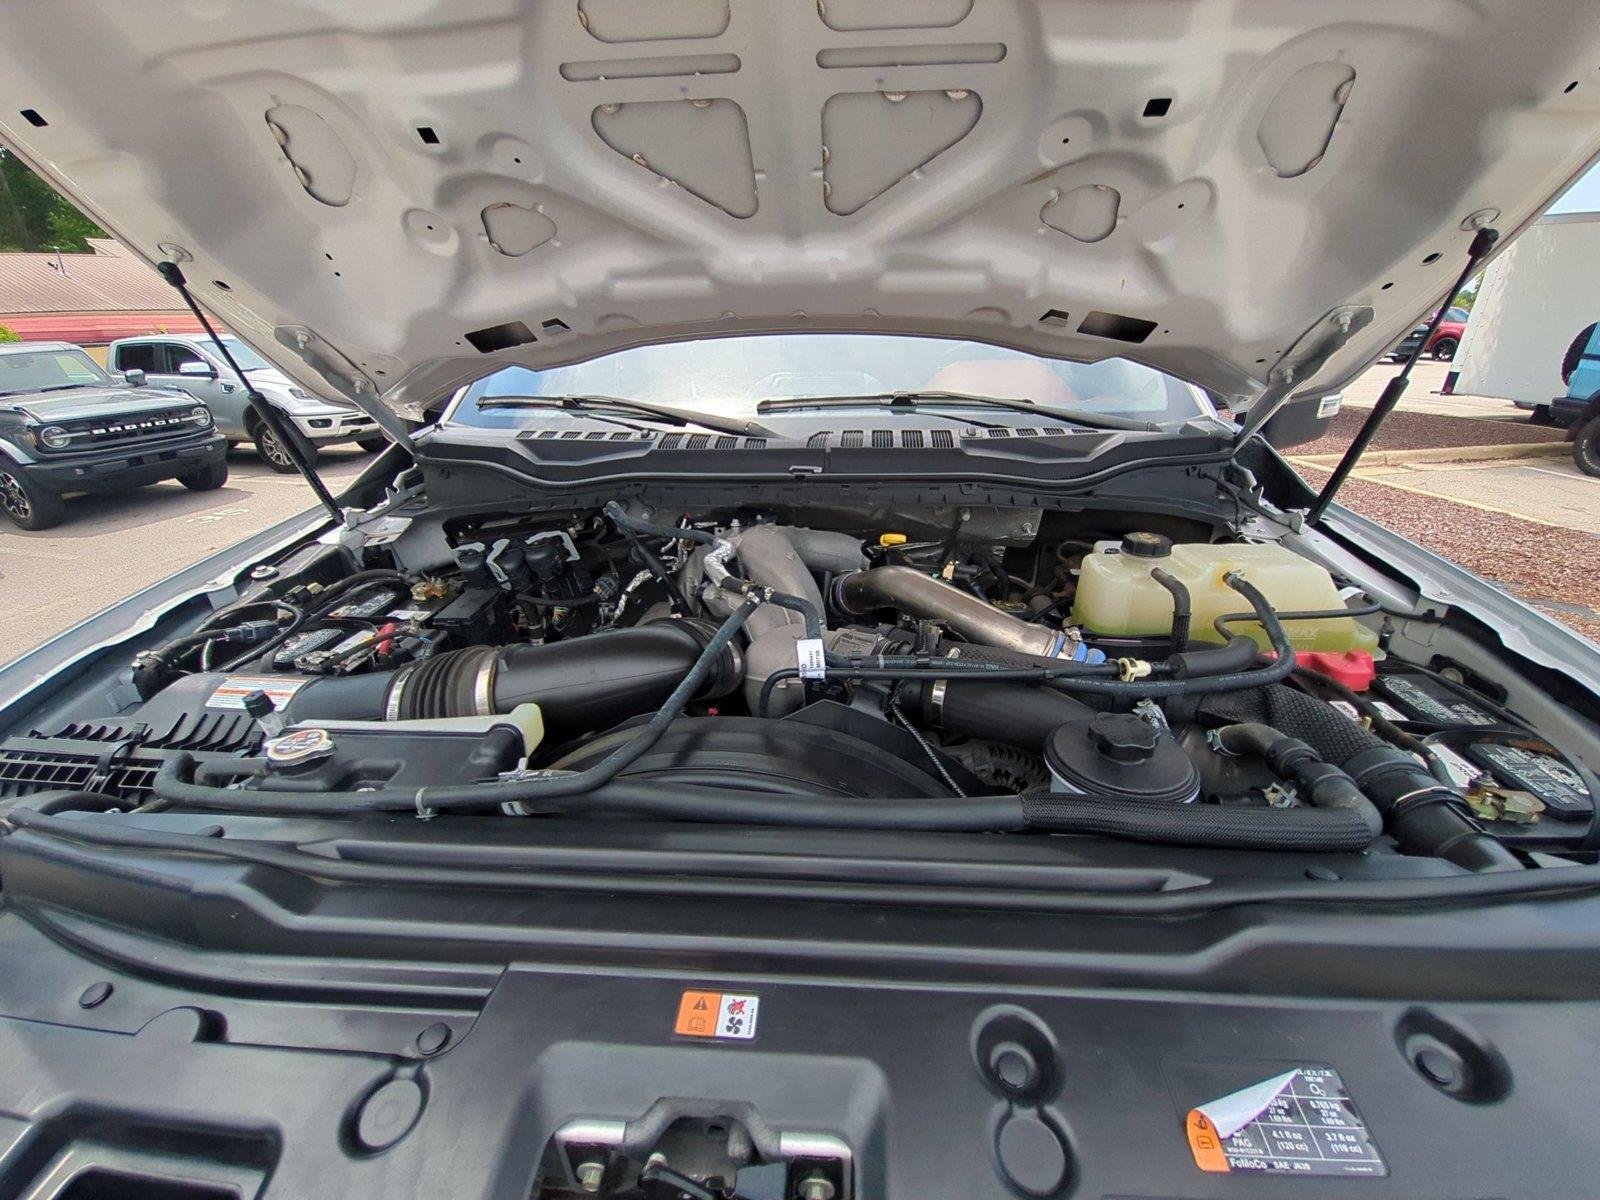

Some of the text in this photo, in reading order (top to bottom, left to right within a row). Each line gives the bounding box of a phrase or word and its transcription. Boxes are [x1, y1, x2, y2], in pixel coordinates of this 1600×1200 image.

[91, 417, 181, 435] BRONCO
[1272, 1130, 1283, 1139] 4.1
[1292, 1132, 1303, 1140] oz
[1325, 1132, 1337, 1141] 3.7
[1232, 1137, 1252, 1147] PAG
[1277, 1141, 1309, 1152] (120 cc)
[1349, 1145, 1363, 1154] cc)
[1229, 1157, 1268, 1170] FoMoCo
[1273, 1161, 1291, 1170] SAE
